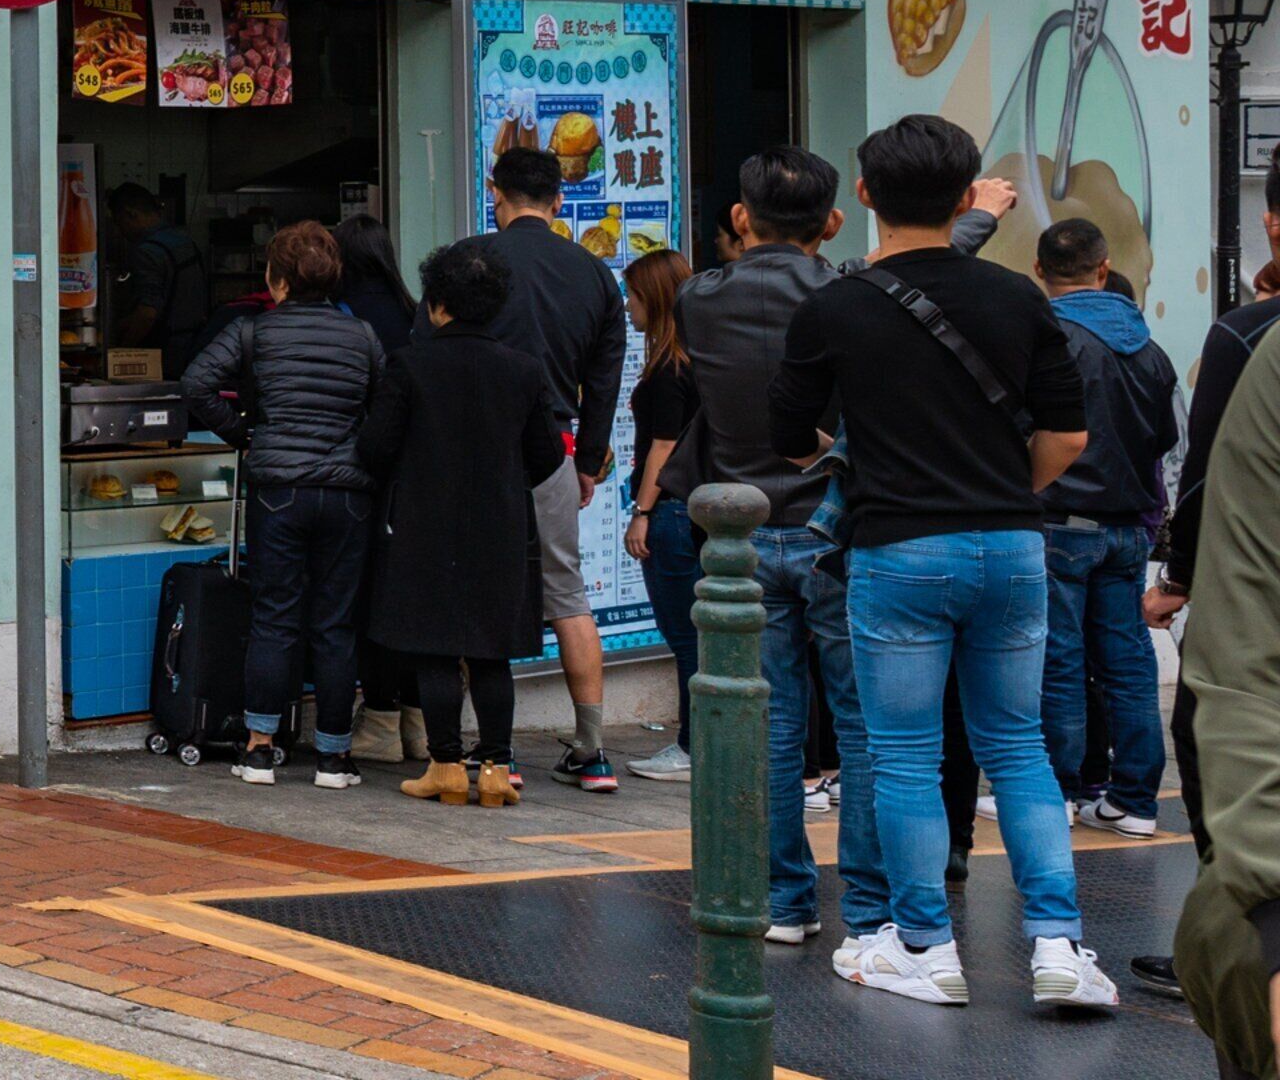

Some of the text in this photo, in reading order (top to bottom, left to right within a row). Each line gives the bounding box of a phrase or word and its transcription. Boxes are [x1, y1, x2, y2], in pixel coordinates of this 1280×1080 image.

[561, 19, 618, 38] 旺記咖啡
[77, 73, 98, 86] $48
[233, 81, 252, 95] $65
[608, 98, 663, 142] 樓上
[608, 145, 665, 191] 雅座
